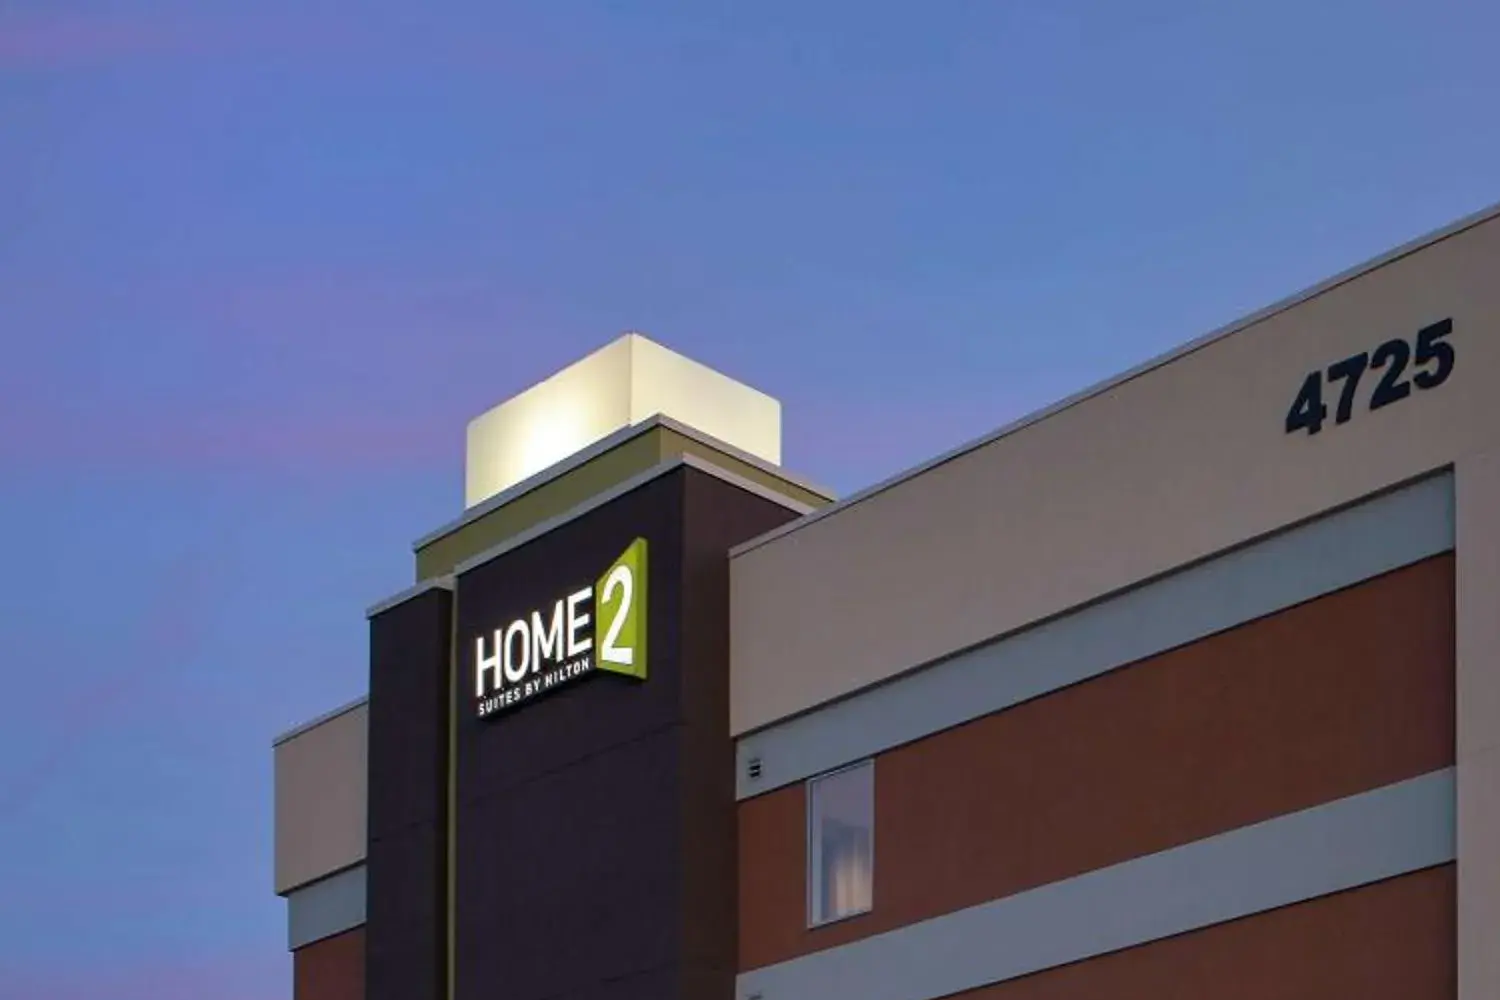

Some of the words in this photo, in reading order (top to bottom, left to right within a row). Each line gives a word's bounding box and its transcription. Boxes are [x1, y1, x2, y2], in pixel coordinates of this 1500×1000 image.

[1285, 317, 1455, 435] 4725
[479, 687, 521, 716] SUITES
[525, 676, 541, 696] BY
[545, 656, 589, 687] HILTON
